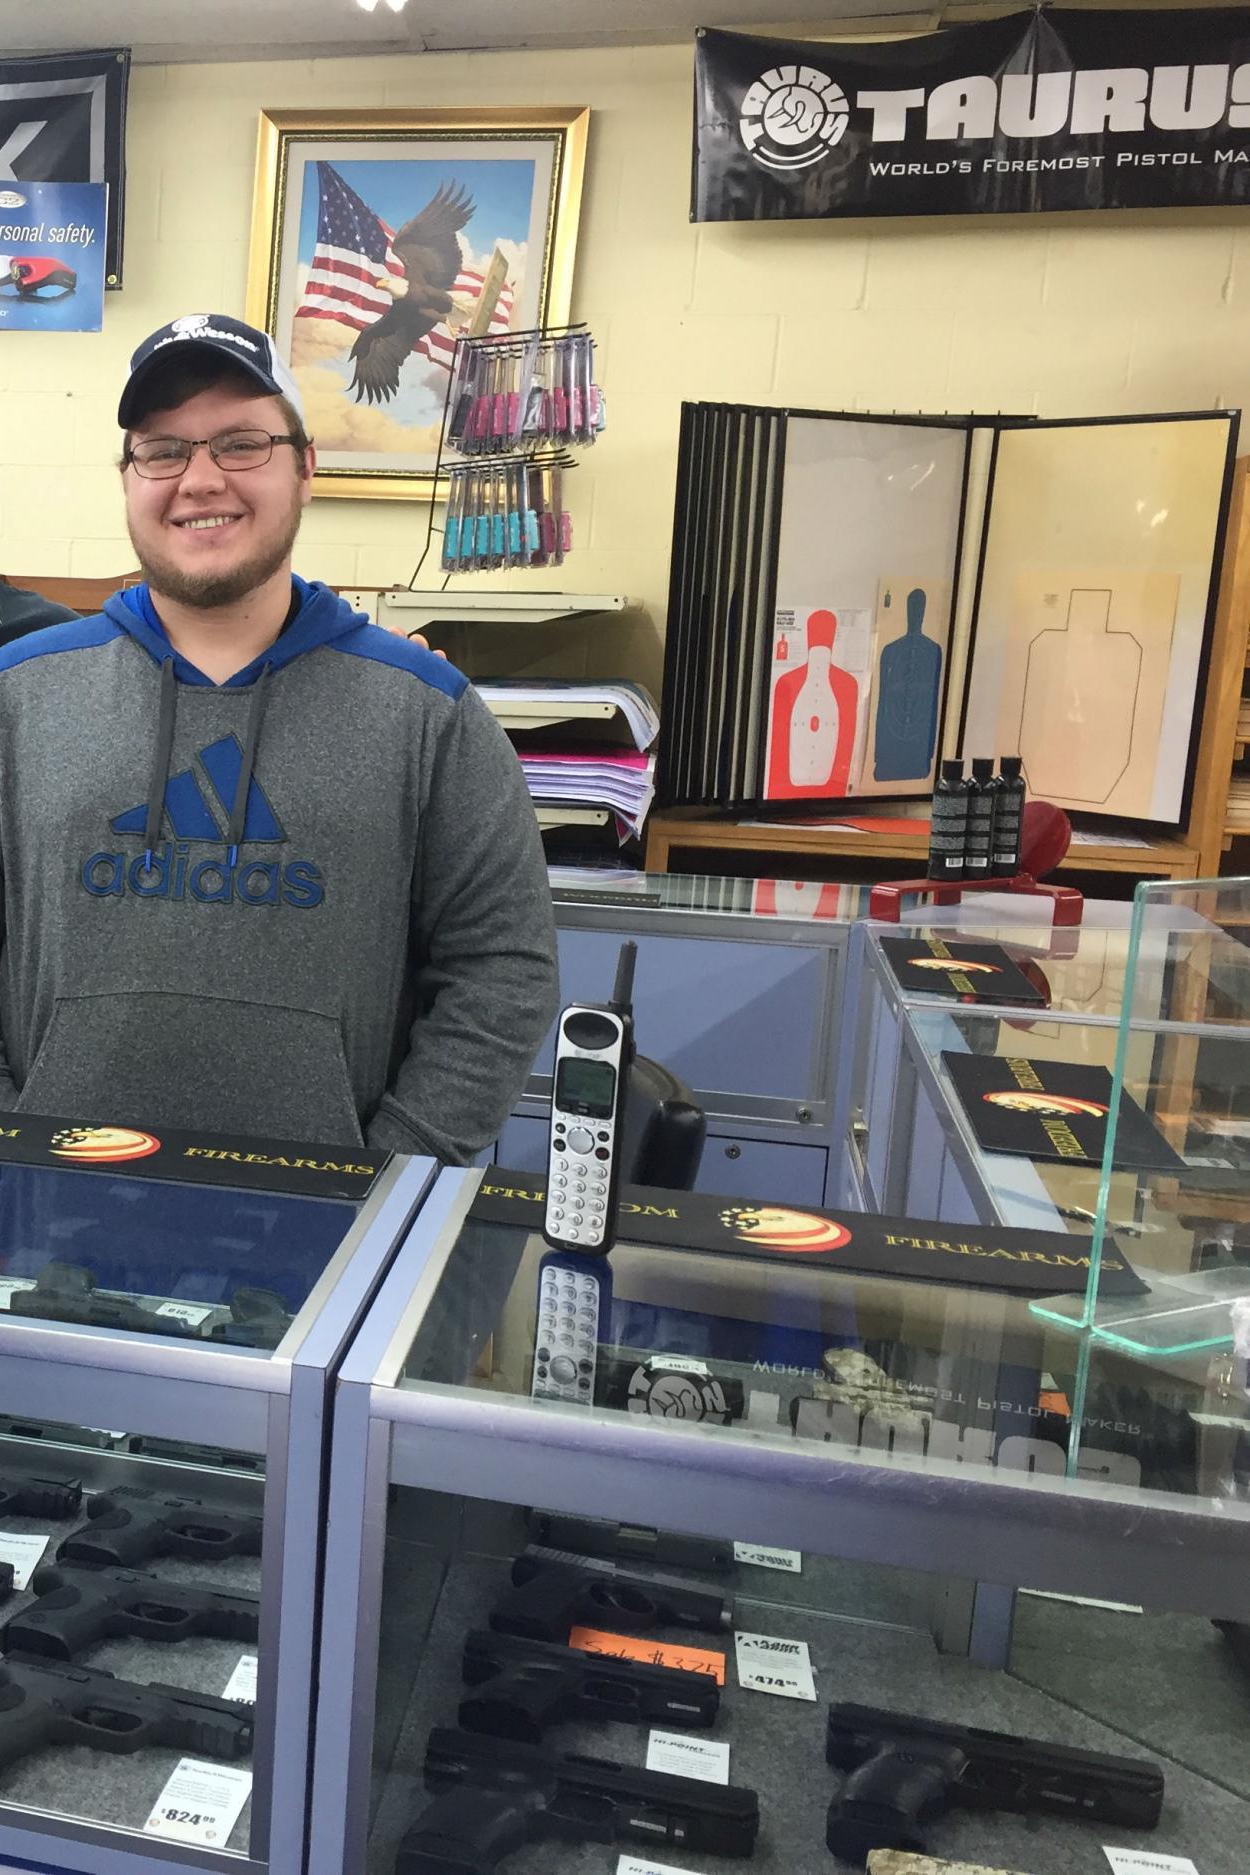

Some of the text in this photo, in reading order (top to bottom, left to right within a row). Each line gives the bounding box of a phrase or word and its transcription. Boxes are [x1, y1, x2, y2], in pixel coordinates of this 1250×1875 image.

[857, 63, 1250, 142] TAURU
[869, 159, 972, 177] WORLD'S
[983, 155, 1106, 174] FOREMOST
[1116, 151, 1202, 168] PISTOL
[48, 224, 95, 248] safety.
[81, 843, 325, 908] adidas
[182, 1147, 374, 1176] FIREARMS
[478, 1184, 680, 1219] FREOM
[885, 1233, 1125, 1270] FIREARMS
